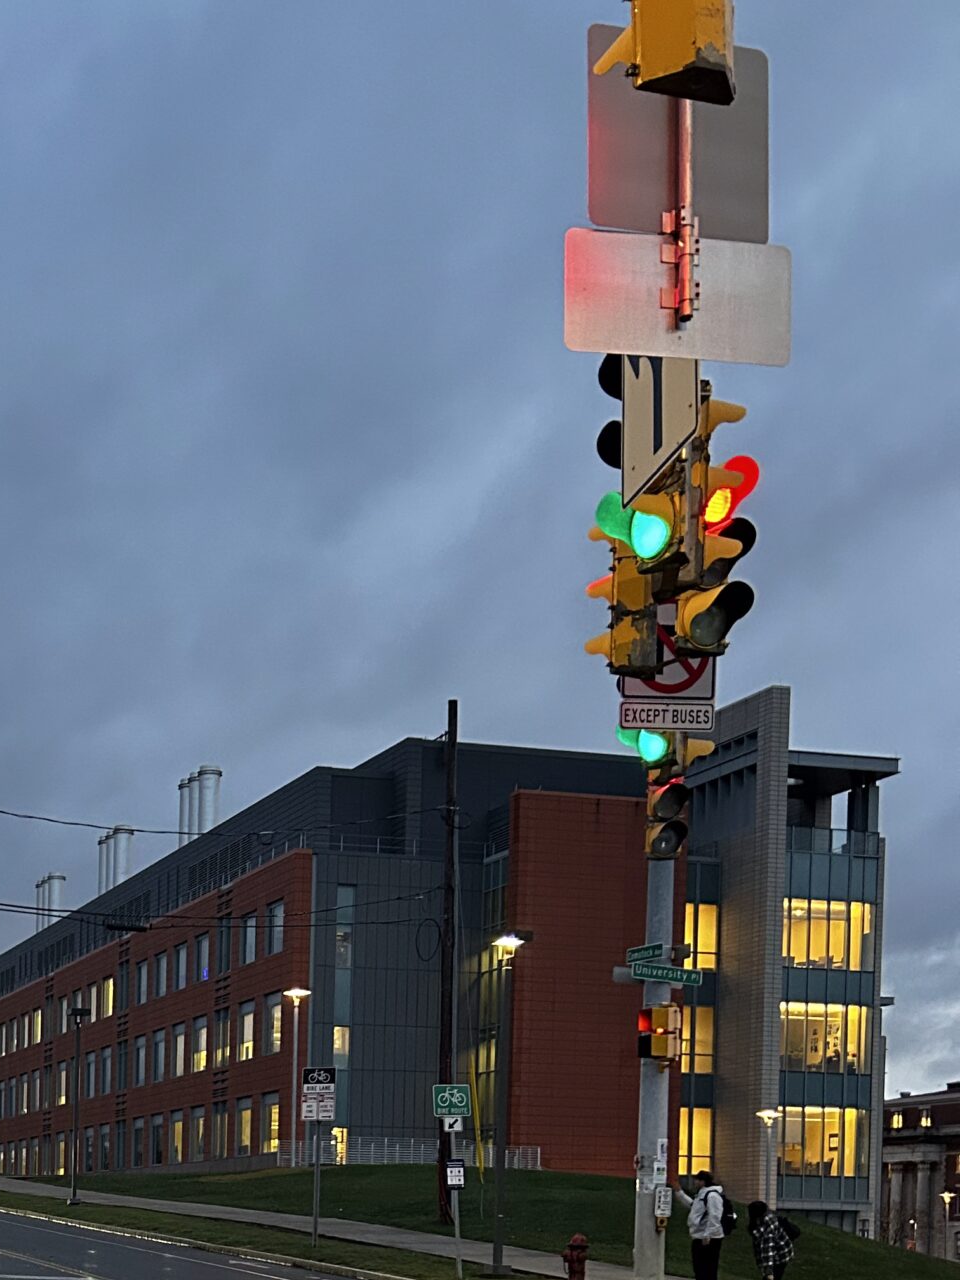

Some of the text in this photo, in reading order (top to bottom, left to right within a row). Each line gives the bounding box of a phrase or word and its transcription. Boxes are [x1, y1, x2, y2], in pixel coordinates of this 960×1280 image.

[624, 708, 710, 724] EXCEPT BUSES
[635, 965, 688, 981] University
[437, 1107, 468, 1115] BIKE ROUTE
